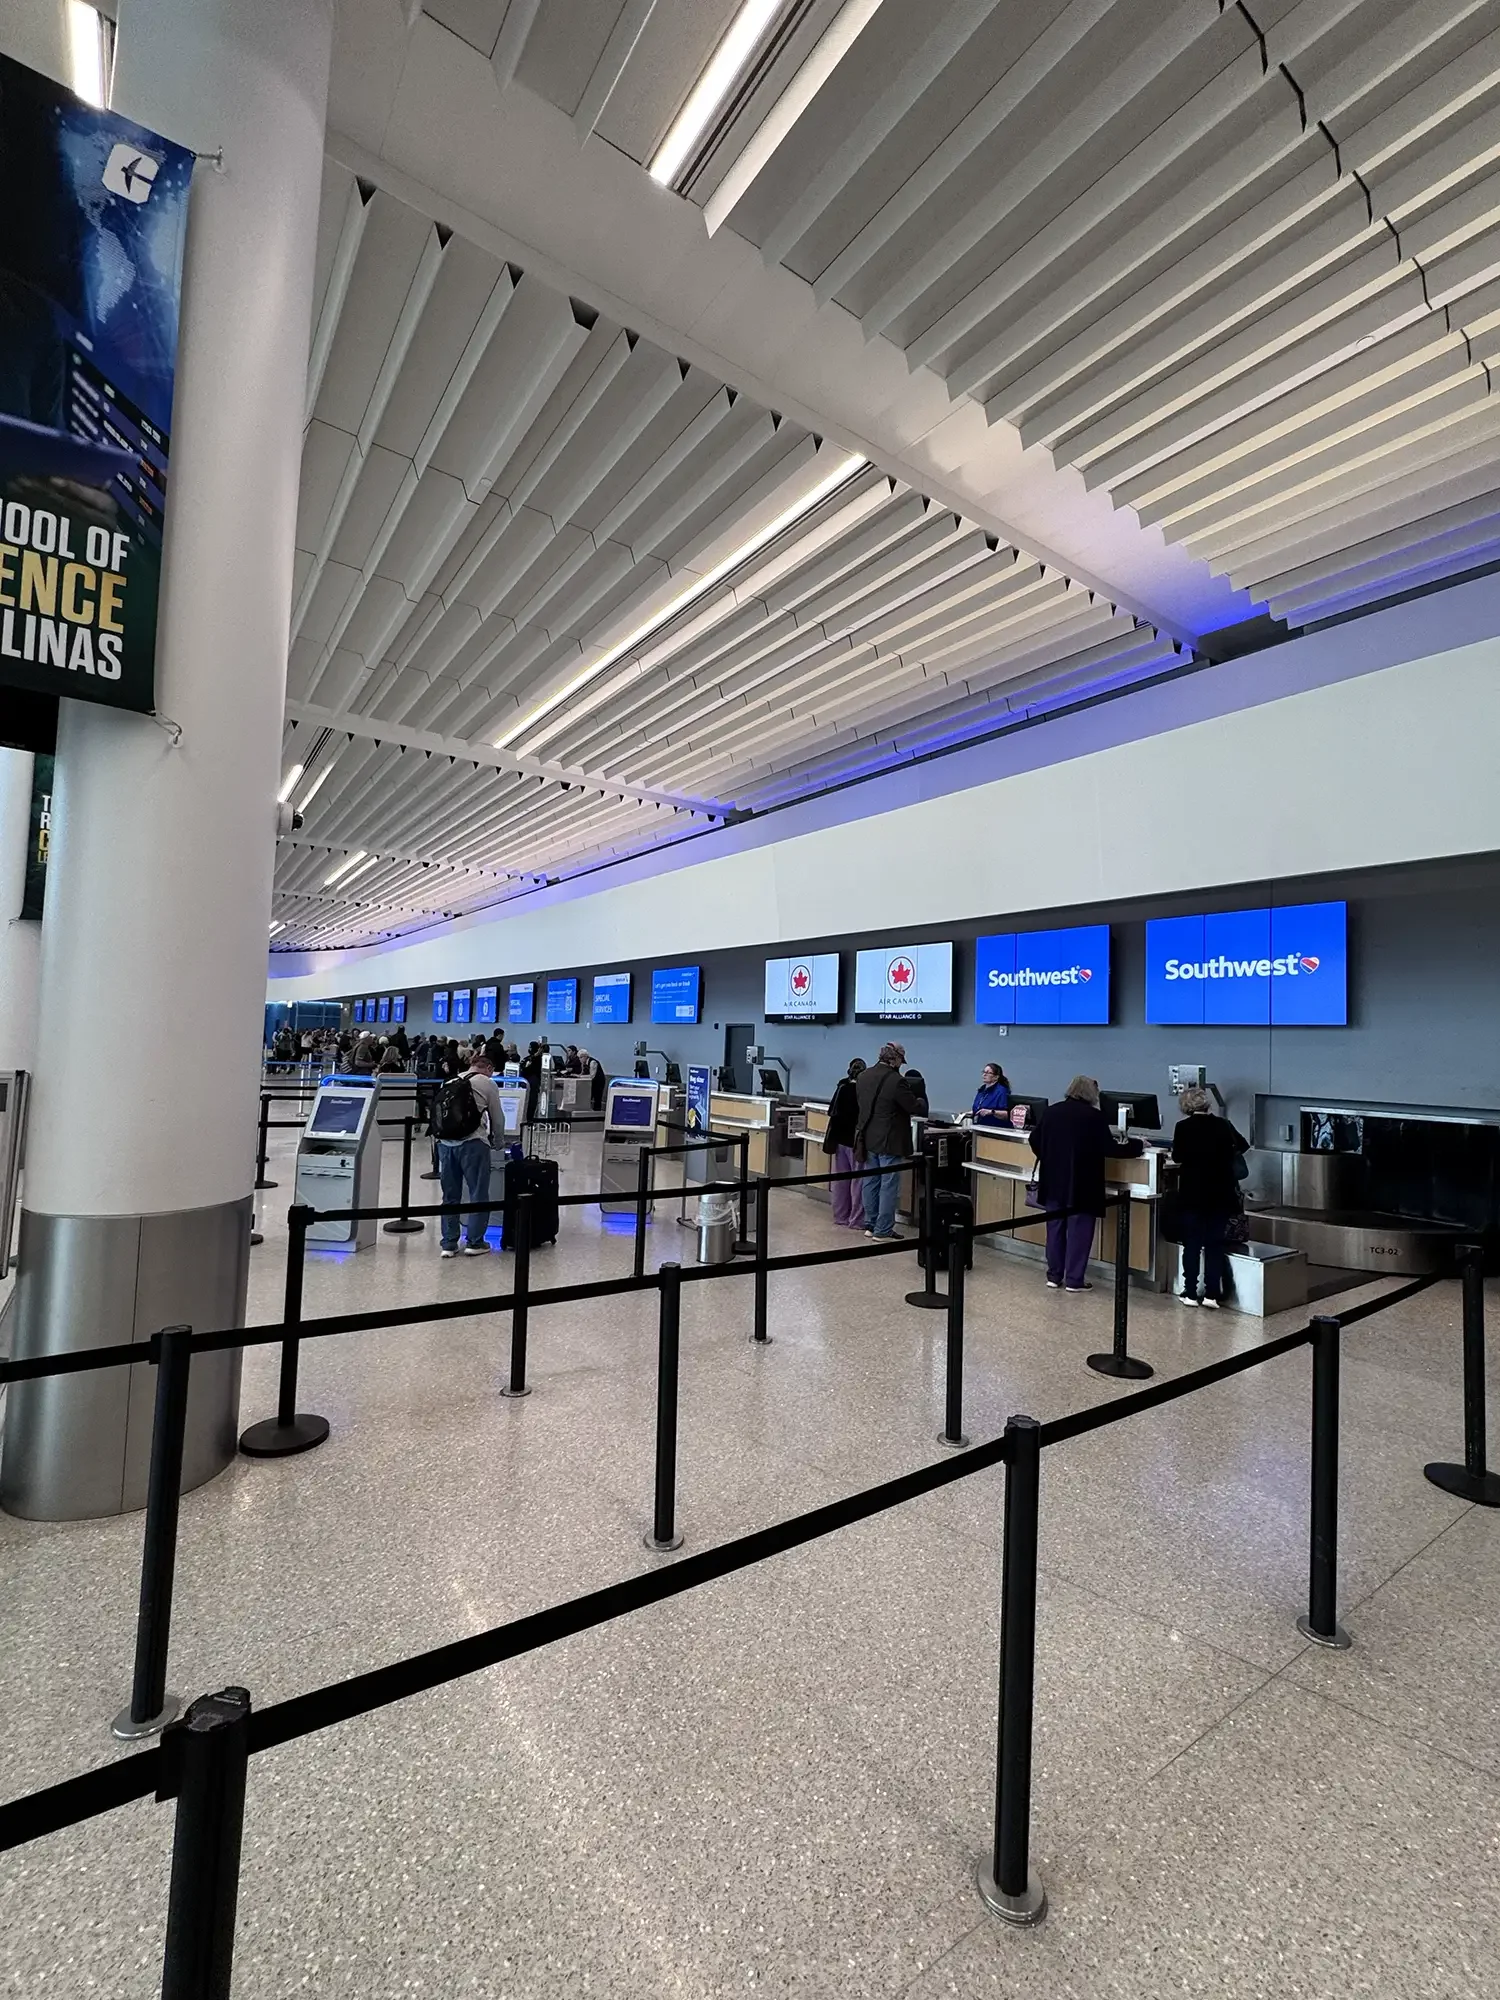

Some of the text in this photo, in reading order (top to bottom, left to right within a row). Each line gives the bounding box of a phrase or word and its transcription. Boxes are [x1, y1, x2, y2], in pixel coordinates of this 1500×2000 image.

[0, 498, 130, 572] OOL OF
[0, 541, 128, 634] ENCE
[1, 608, 123, 680] LINAS
[988, 967, 1078, 987] Southwest
[1165, 953, 1299, 980] Southwest
[892, 997, 924, 1005] CANADA
[1369, 1246, 1399, 1256] TC3-02
